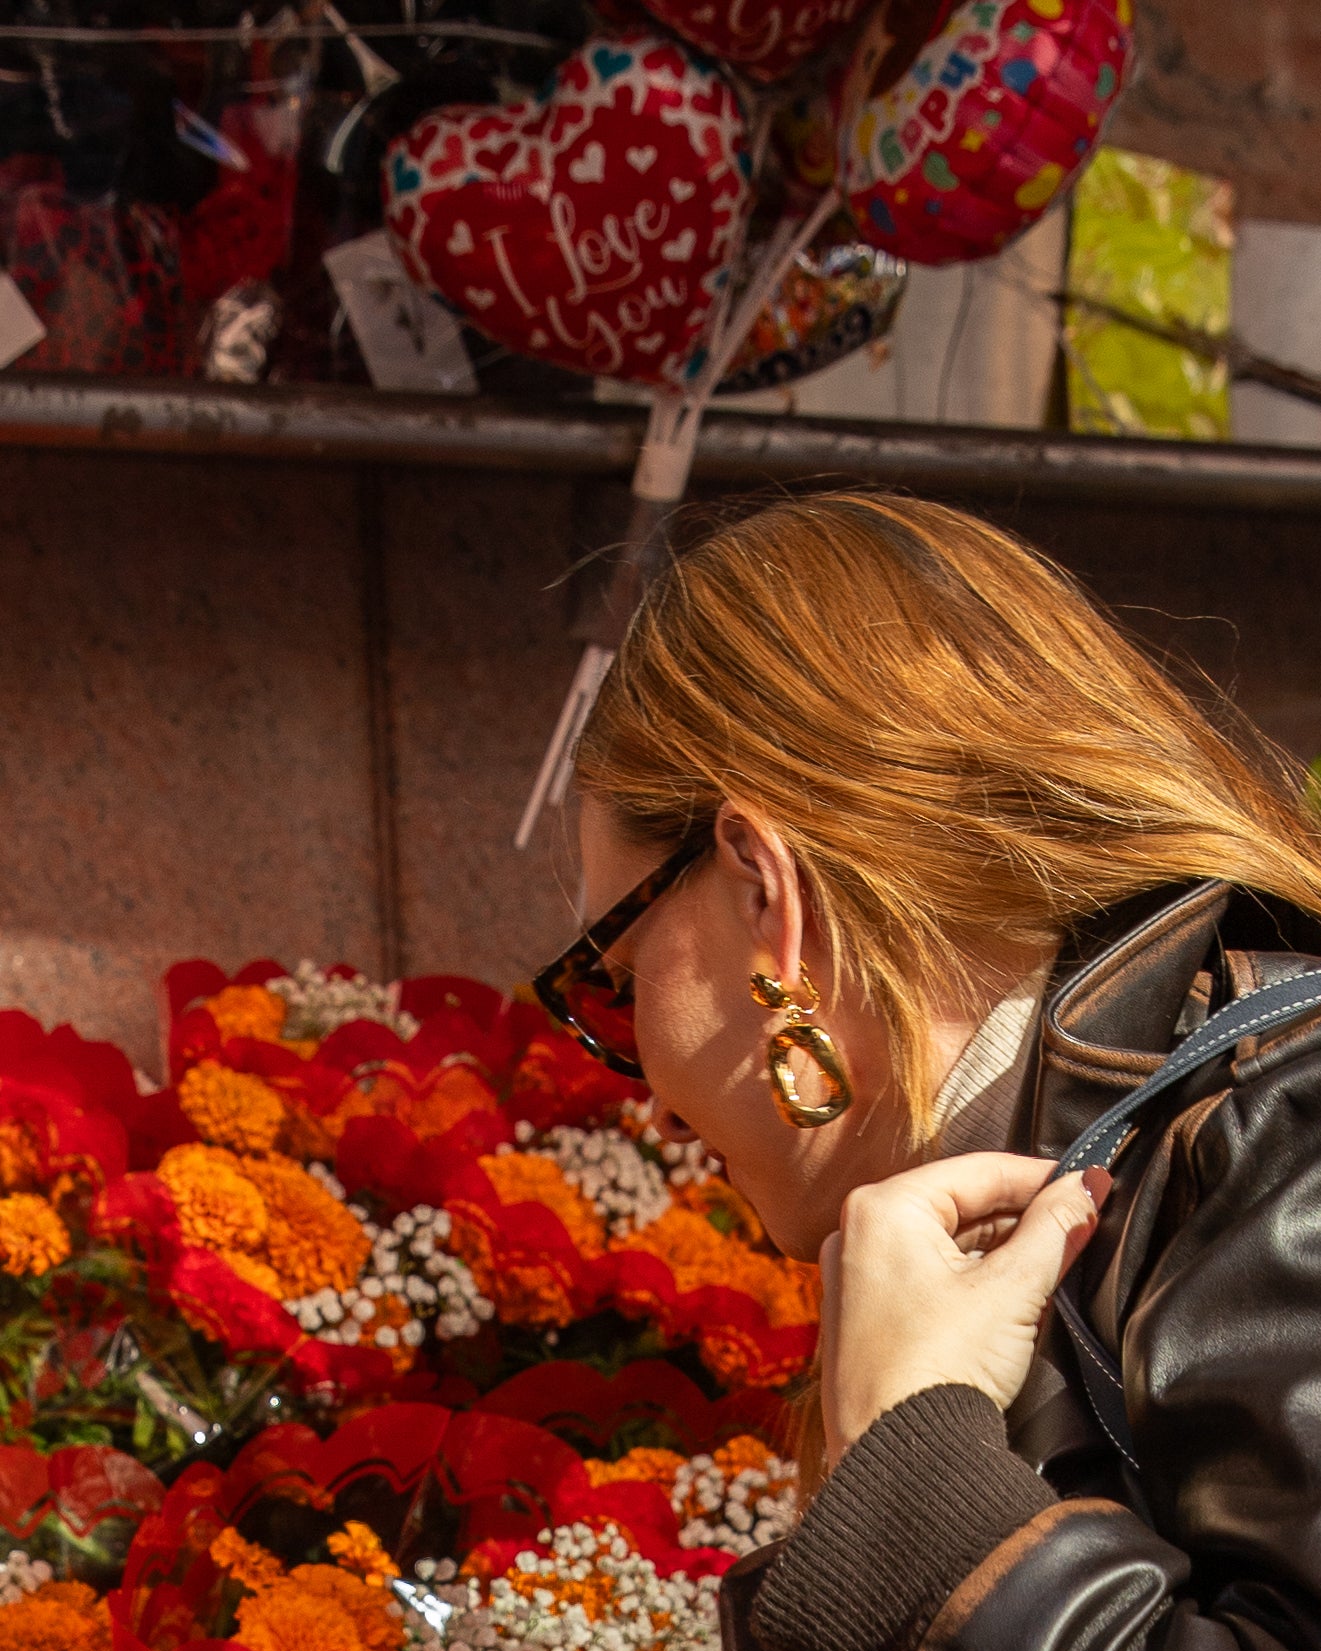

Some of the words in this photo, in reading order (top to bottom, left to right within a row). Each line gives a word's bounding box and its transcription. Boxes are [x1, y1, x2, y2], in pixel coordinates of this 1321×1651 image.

[482, 223, 540, 320] I
[545, 190, 671, 307] Love
[544, 274, 689, 376] You
